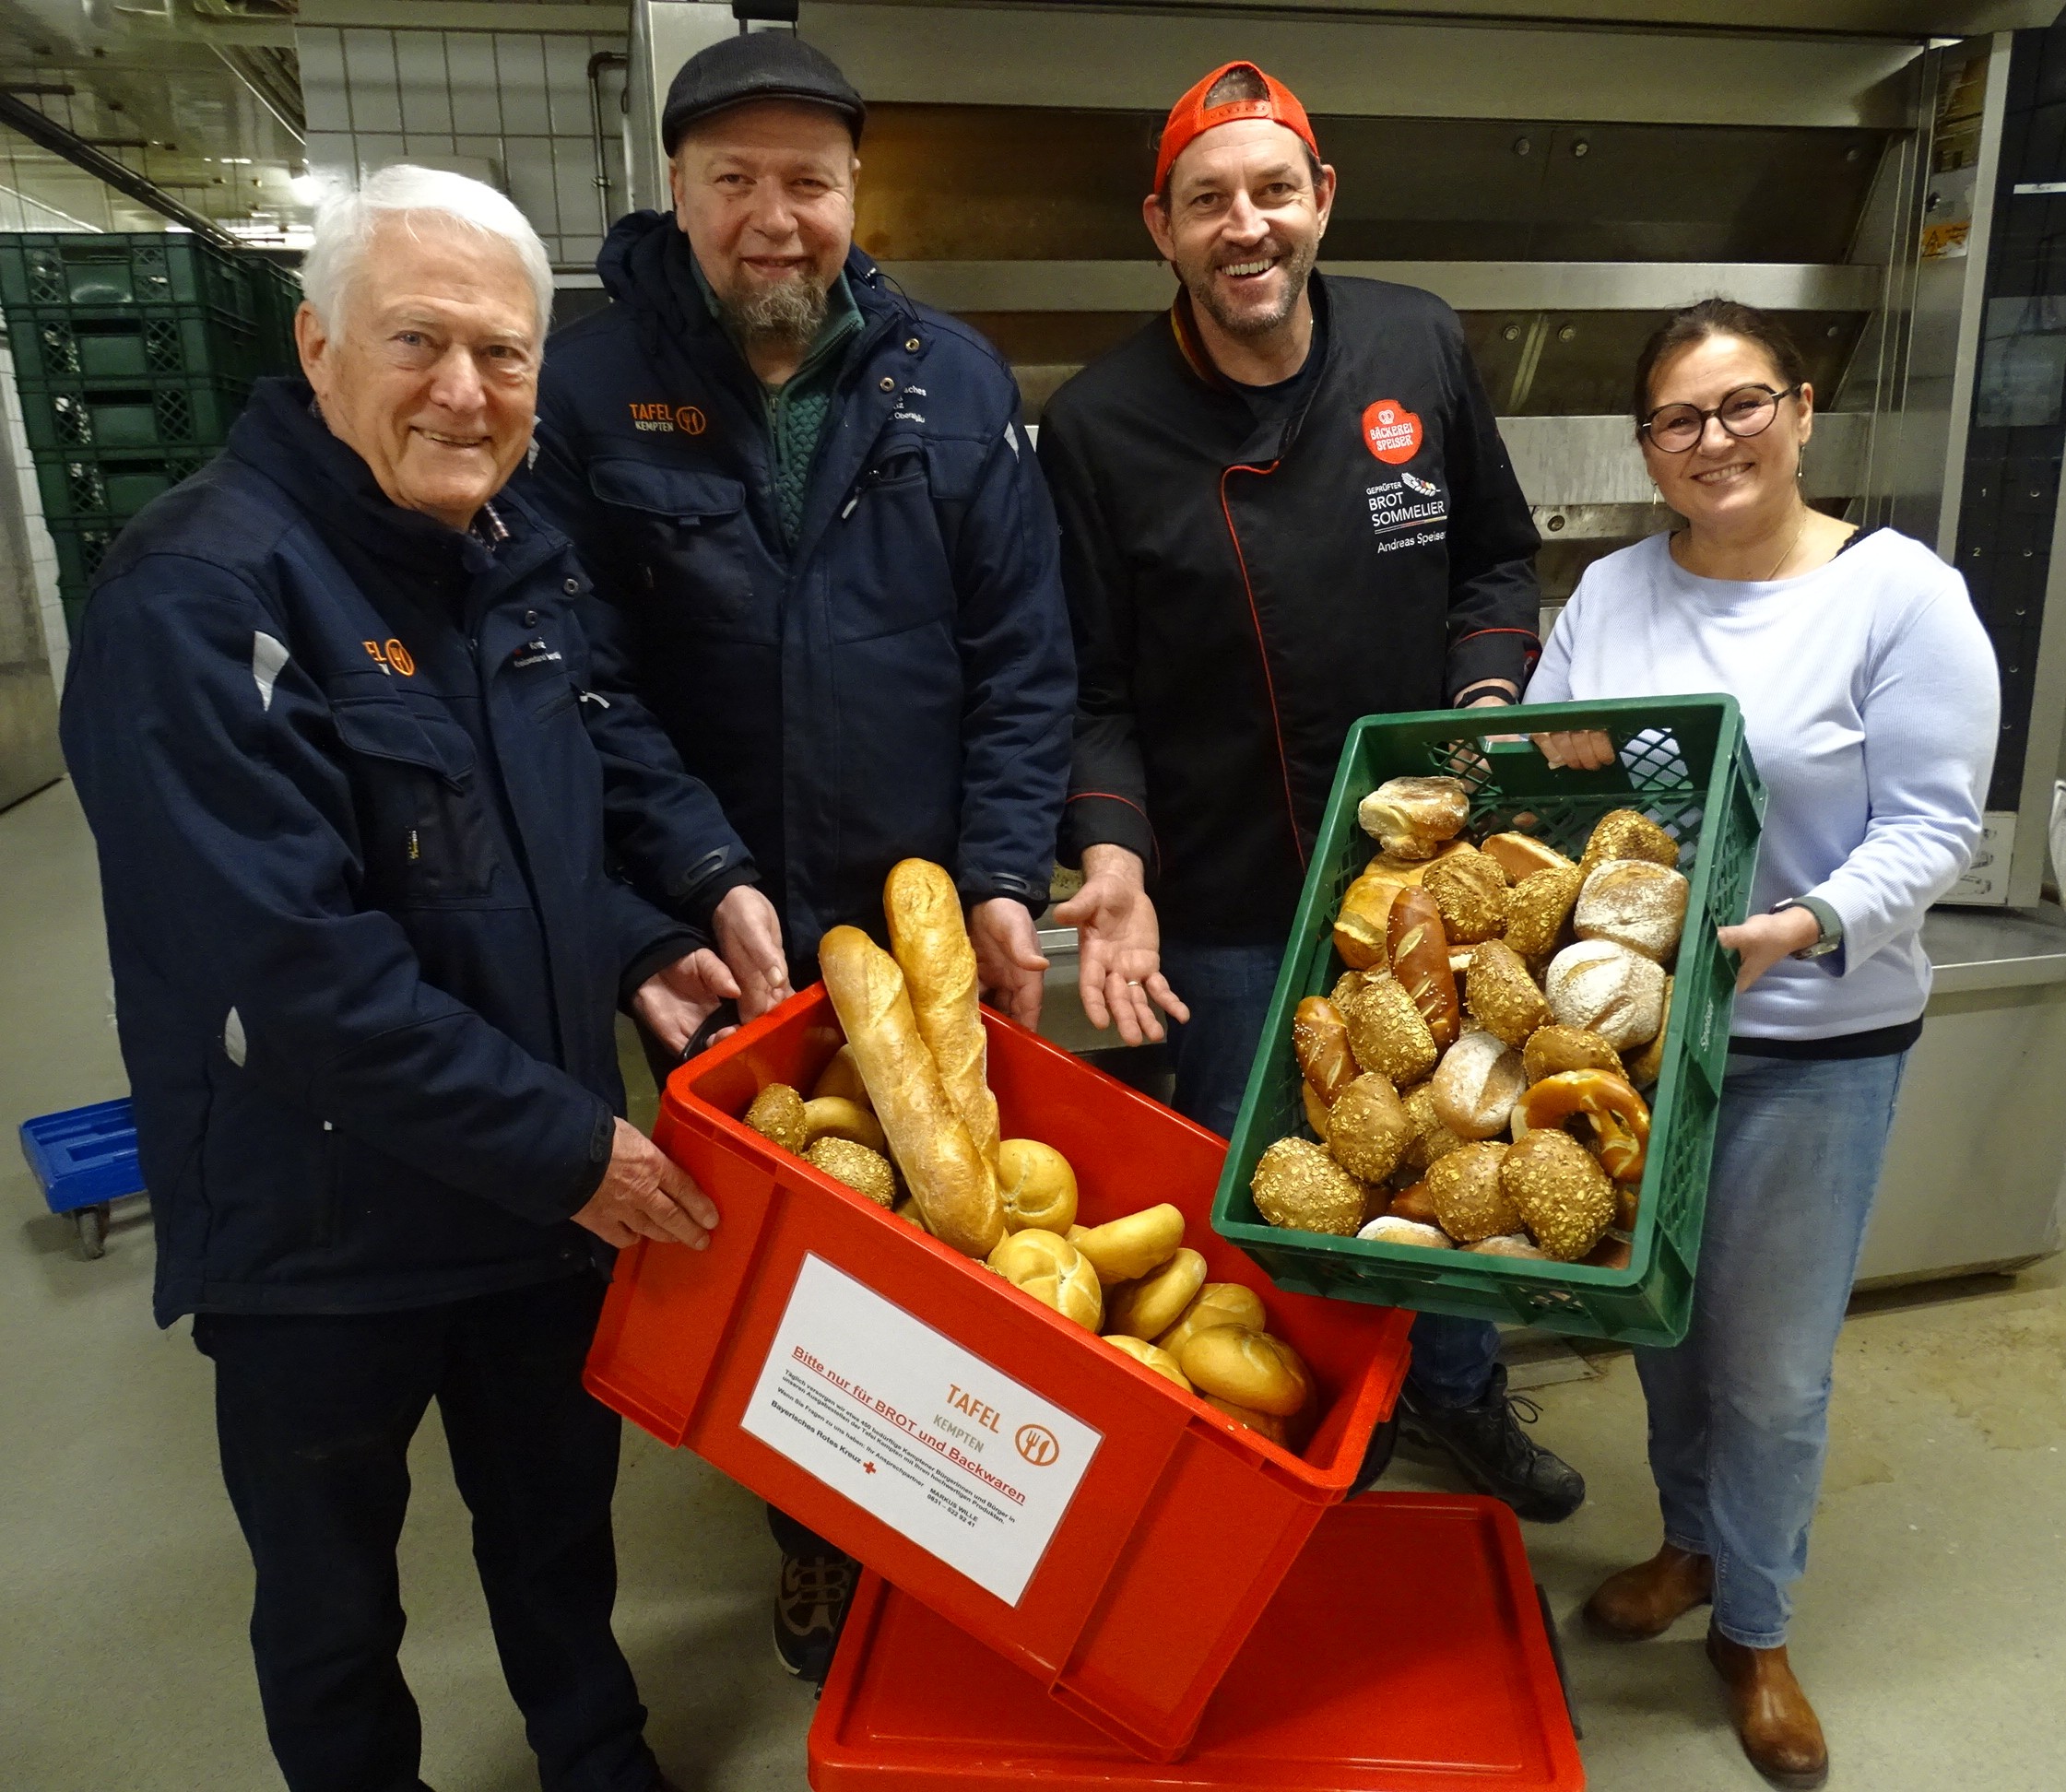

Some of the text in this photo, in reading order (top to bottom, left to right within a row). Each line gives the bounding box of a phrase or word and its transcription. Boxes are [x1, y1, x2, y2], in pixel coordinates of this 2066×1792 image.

[629, 404, 674, 420] TAFEL
[635, 420, 674, 431] KEMPTEN
[1370, 422, 1413, 441] BÄCKEREI
[1376, 434, 1413, 451] SPEISER
[1366, 481, 1402, 495] GEPRÜFTER
[1369, 491, 1404, 511] BROT
[1372, 501, 1446, 527] SOMMELIER
[1377, 536, 1415, 554] Andreas
[947, 1384, 1000, 1433] TAFEL
[771, 1399, 861, 1464] Bayerisches Rotes Kreuz
[777, 1385, 794, 1401] Wenn
[794, 1397, 804, 1408] Sie
[804, 1404, 825, 1421] Fragen
[824, 1419, 833, 1427] zu
[832, 1424, 844, 1434] uns
[865, 1445, 875, 1455] Ihr
[875, 1452, 924, 1487] Ansprechpartner
[793, 1345, 1025, 1503] Bitte nur für BROT und Backwaren
[933, 1414, 984, 1453] KEMPTEN
[782, 1375, 806, 1394] unseren
[806, 1391, 850, 1423] Ausgabestellen
[849, 1421, 861, 1430] der
[861, 1427, 877, 1440] Tafel
[876, 1437, 903, 1458] Kempten
[903, 1456, 914, 1466] mit
[930, 1473, 972, 1503] hochwertigen
[785, 1368, 806, 1386] Täglich
[806, 1384, 835, 1406] versorgen
[835, 1403, 845, 1412] wir
[844, 1410, 860, 1422] etwa
[871, 1427, 902, 1450] bedürftige
[902, 1447, 935, 1471] Kemptener
[935, 1468, 973, 1496] Bürgerinnen
[973, 1493, 986, 1504] und
[986, 1501, 1009, 1518] Bürger
[1008, 1515, 1015, 1523] in
[929, 1487, 978, 1522] MARKUS WILLE
[946, 1506, 959, 1517] 522
[958, 1514, 967, 1523] 92
